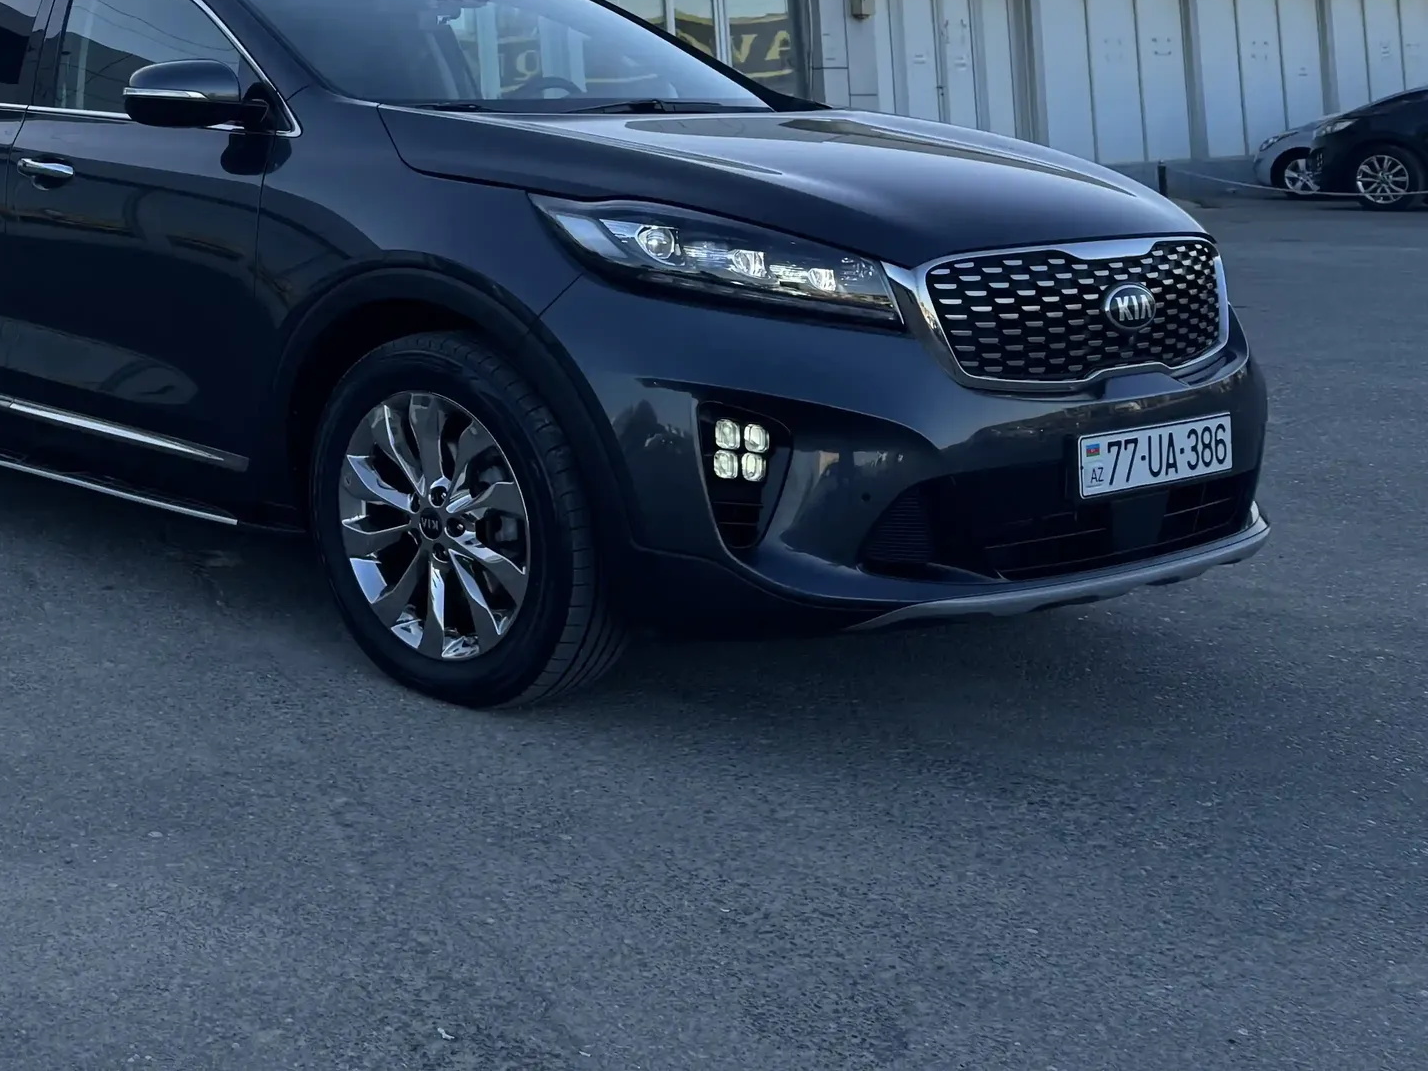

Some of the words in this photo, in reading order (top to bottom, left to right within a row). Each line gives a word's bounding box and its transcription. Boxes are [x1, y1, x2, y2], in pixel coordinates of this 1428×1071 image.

[1115, 294, 1152, 321] KIA
[1090, 467, 1104, 484] AZ
[421, 517, 439, 531] KIA
